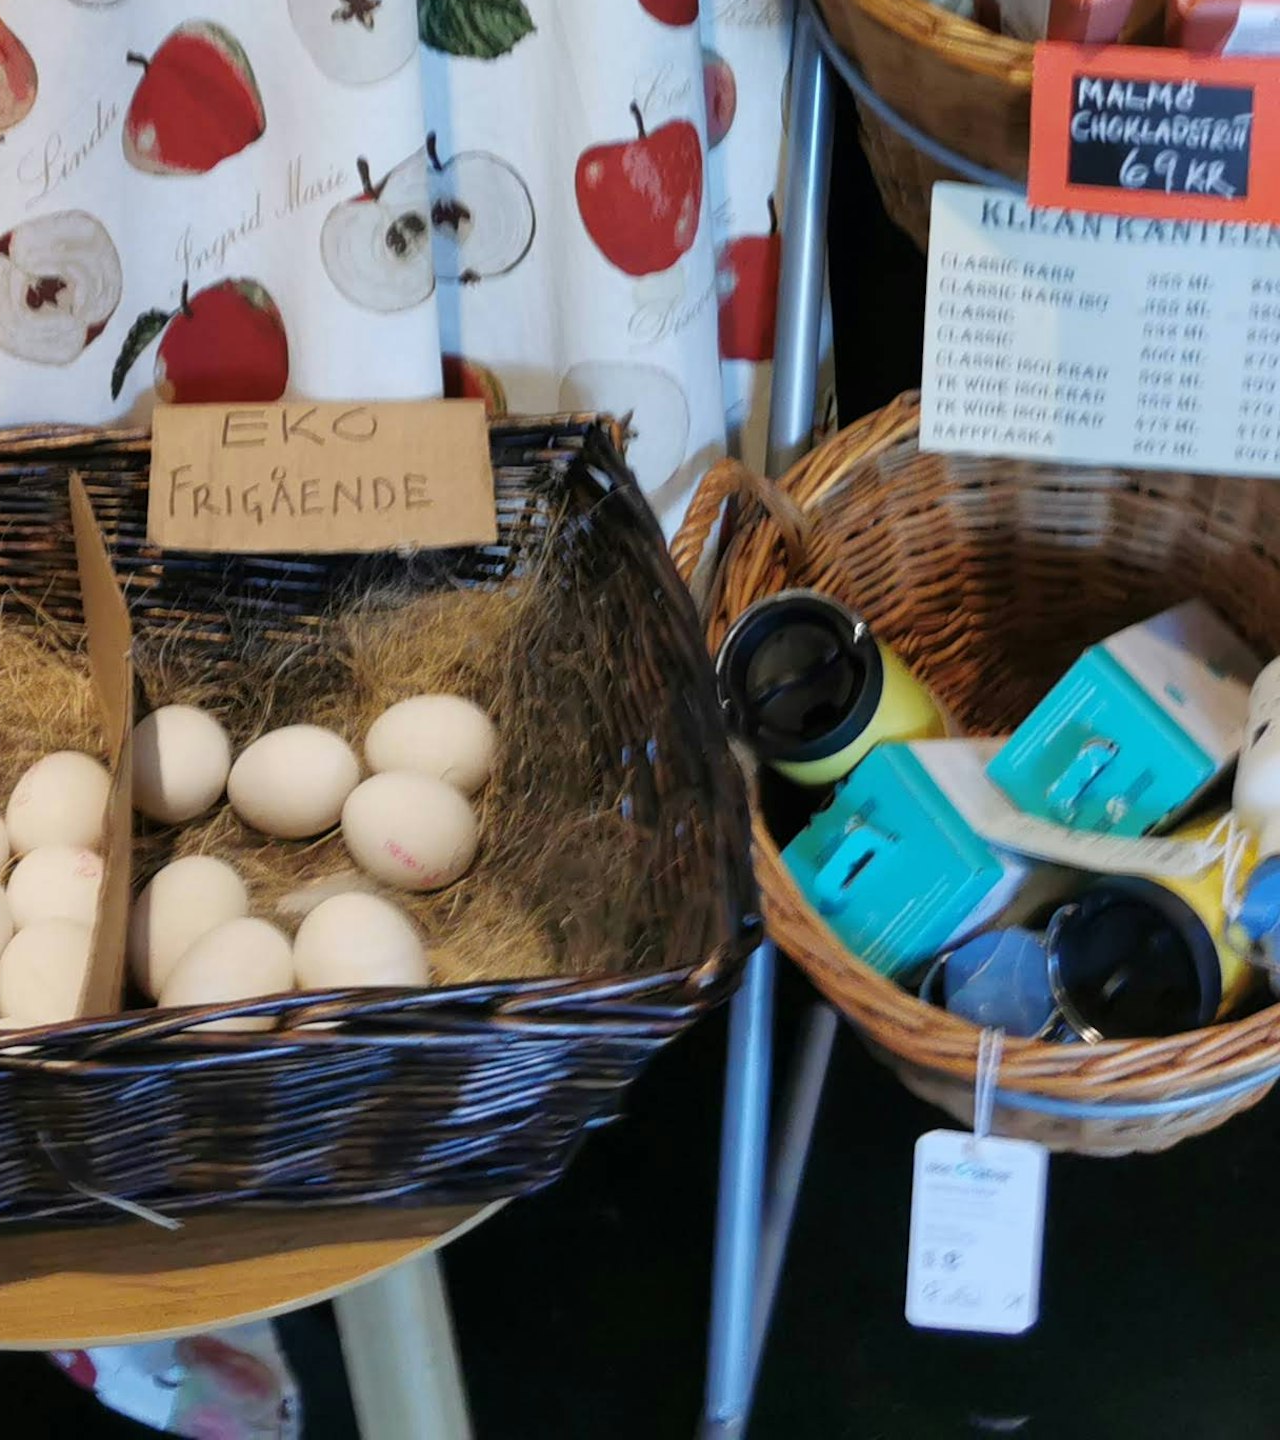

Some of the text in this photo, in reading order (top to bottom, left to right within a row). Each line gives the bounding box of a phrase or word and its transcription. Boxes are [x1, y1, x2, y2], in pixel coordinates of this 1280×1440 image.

[1077, 75, 1198, 112] MALMÖ
[18, 100, 120, 212] Linda
[1119, 146, 1180, 194] 69
[173, 154, 349, 280] Ingrid Marie
[981, 196, 1103, 241] KLEAN
[221, 406, 378, 449] EKO
[169, 463, 434, 526] FRIGÅENDE
